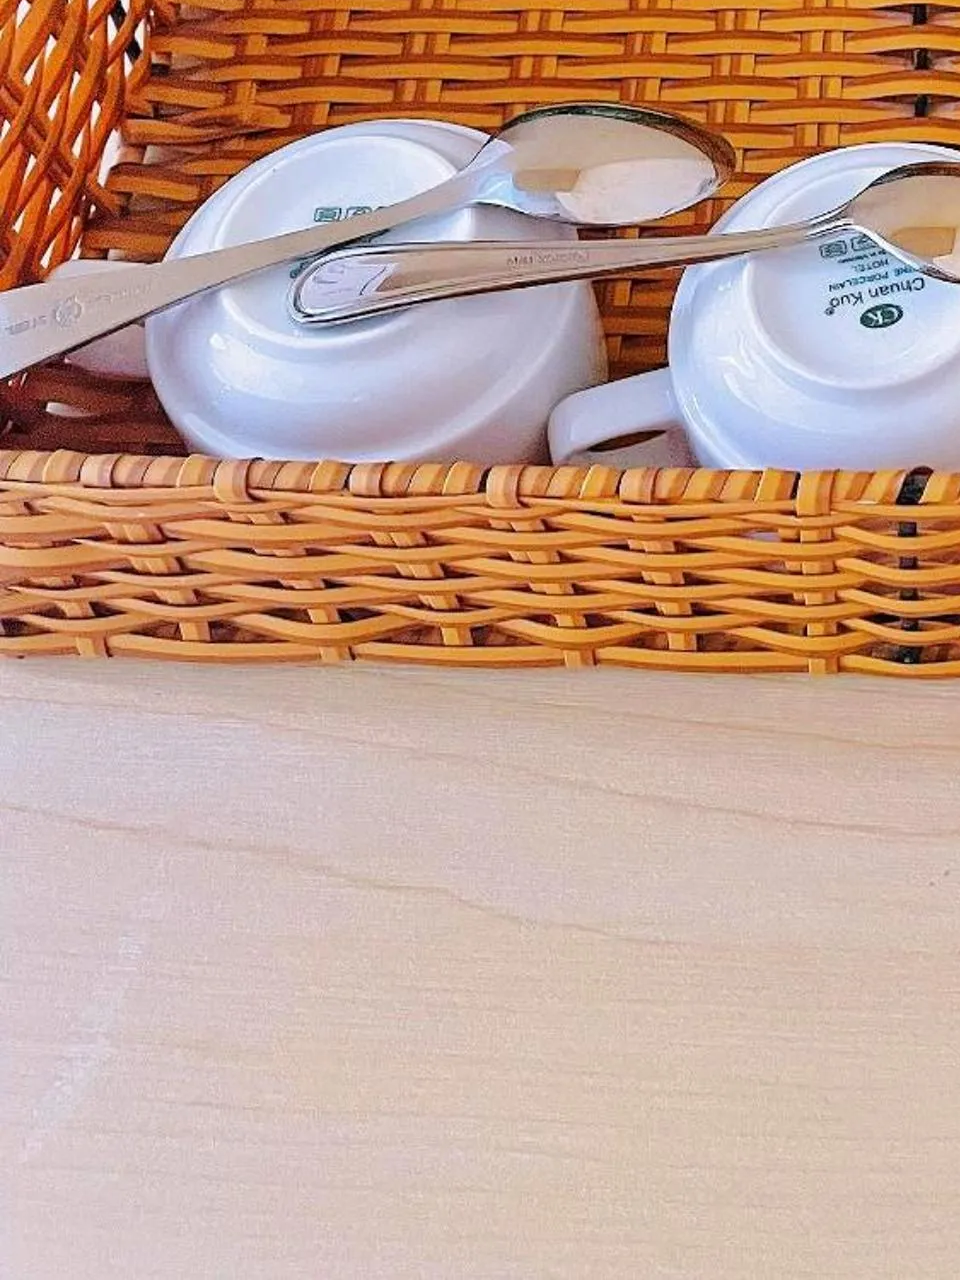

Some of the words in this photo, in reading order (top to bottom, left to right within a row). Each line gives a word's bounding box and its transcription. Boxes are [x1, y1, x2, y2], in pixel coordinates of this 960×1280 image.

[851, 259, 890, 272] HOTEL
[828, 271, 890, 293] PORCELAIN
[868, 277, 926, 298] Chuan
